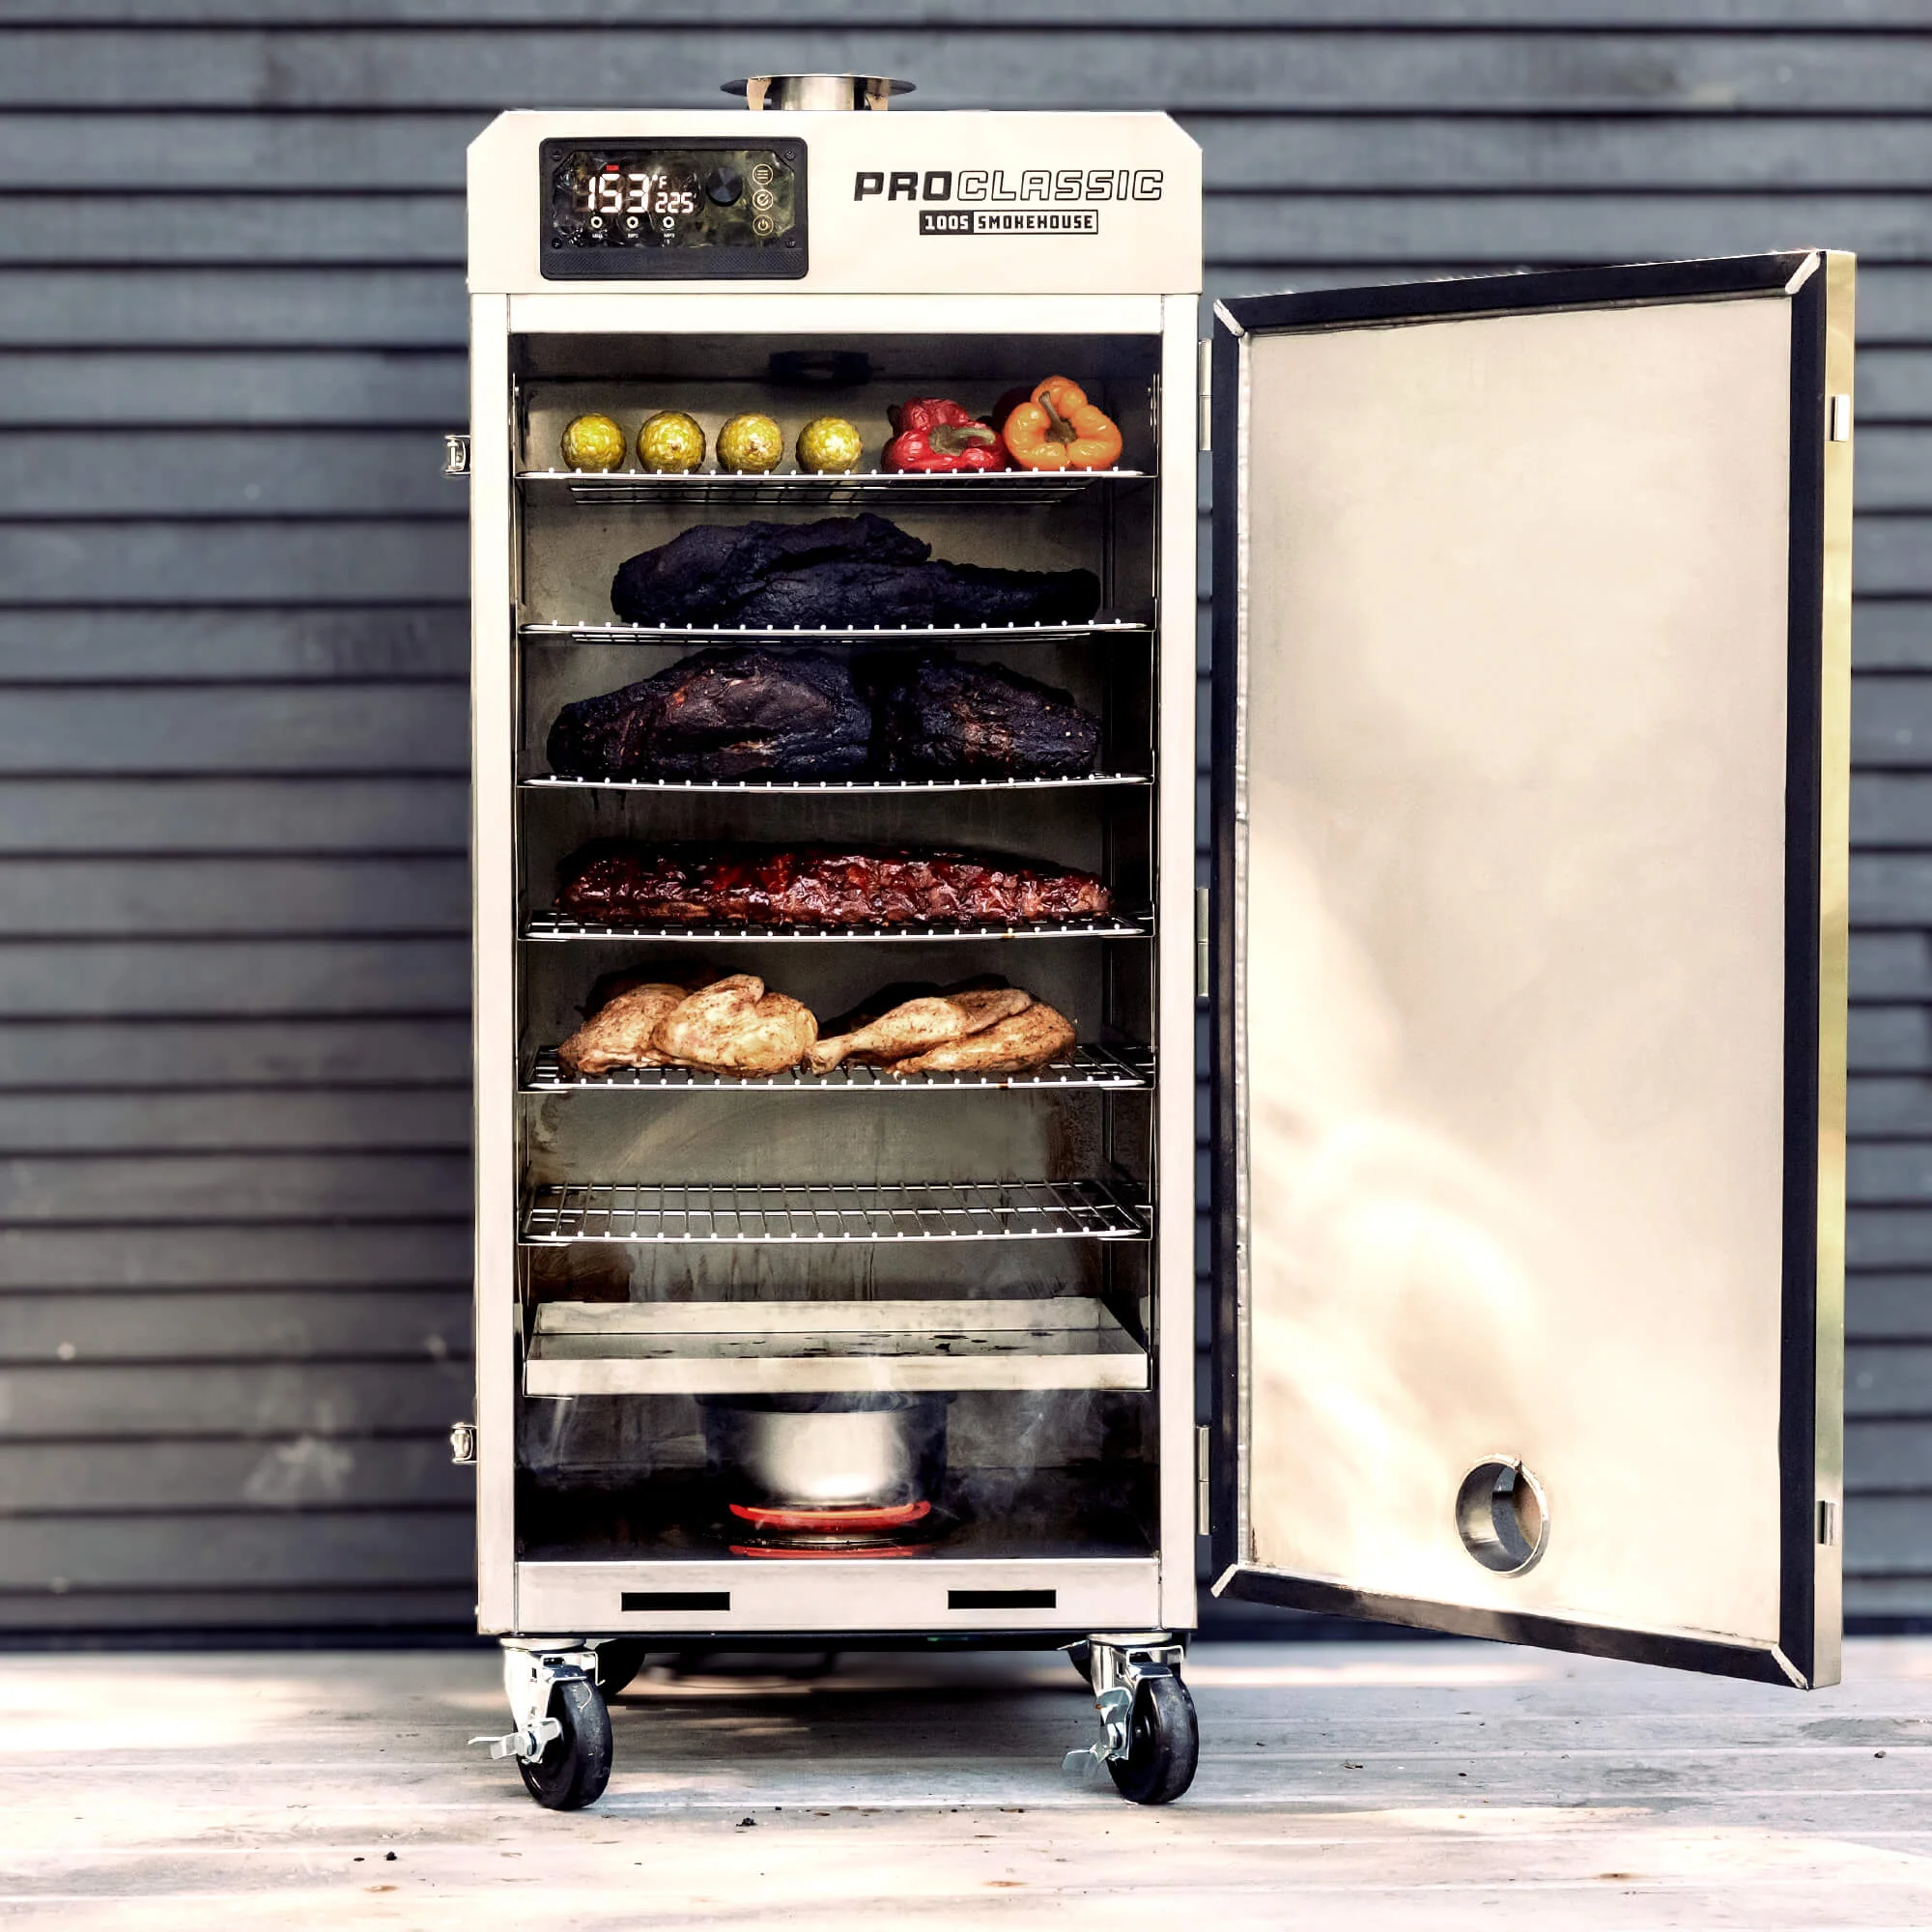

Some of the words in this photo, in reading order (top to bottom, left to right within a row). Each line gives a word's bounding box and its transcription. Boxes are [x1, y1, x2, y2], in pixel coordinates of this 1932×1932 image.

[587, 174, 650, 213] 153
[854, 170, 1164, 201] PROCLASSIC
[655, 192, 695, 213] 225
[978, 214, 1094, 230] SMOKEHOUSE
